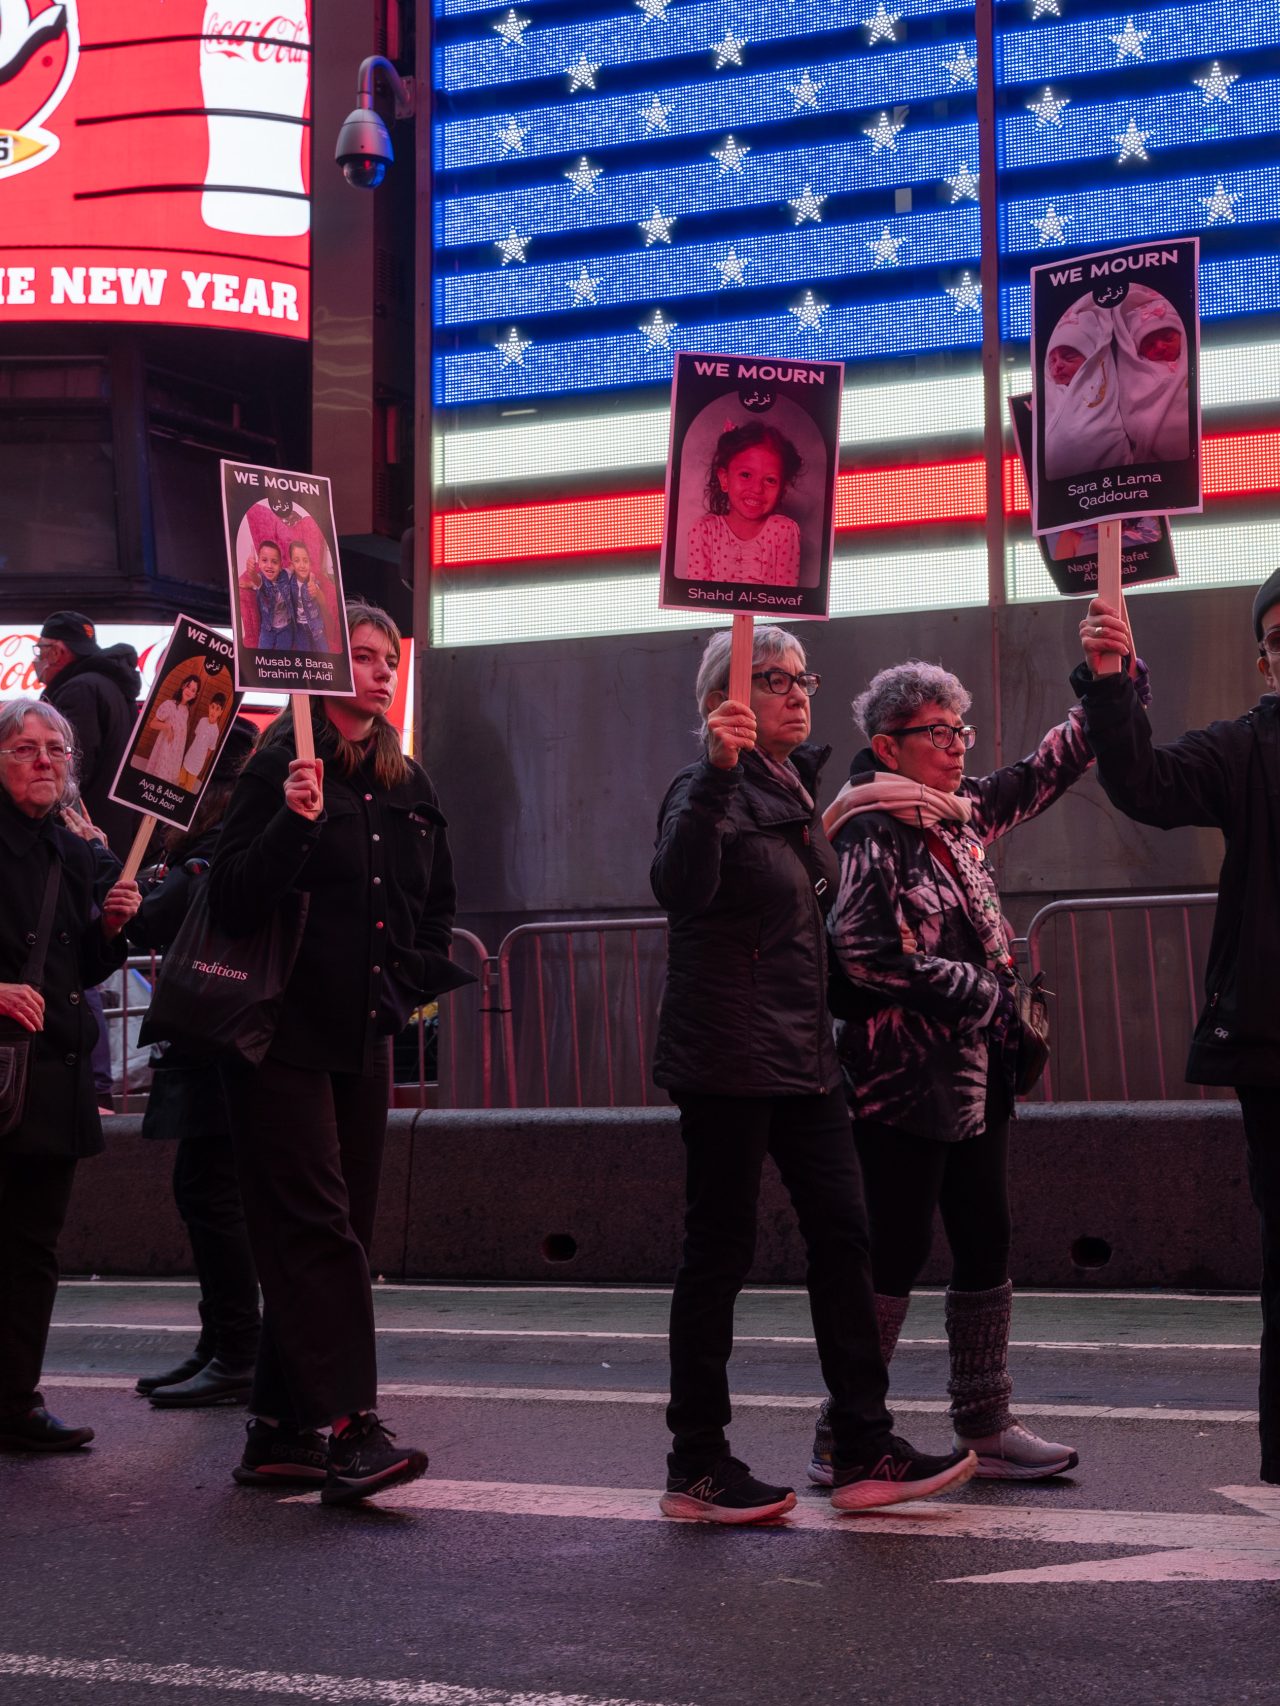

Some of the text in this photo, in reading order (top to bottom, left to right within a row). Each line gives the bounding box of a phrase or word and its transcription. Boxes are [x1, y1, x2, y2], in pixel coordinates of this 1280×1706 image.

[204, 12, 308, 63] Coca-Cola
[1049, 249, 1178, 287] WE MOURN
[0, 267, 299, 321] E NEW YEAR
[1097, 286, 1124, 303] نرثي
[694, 361, 825, 384] WE MOURN
[743, 391, 771, 406] نرثي
[233, 470, 320, 496] WE MOURN
[1067, 473, 1162, 496] Sara & Lama
[1079, 489, 1149, 510] Qaddoura
[1067, 560, 1098, 574] Nagh
[687, 587, 804, 606] Shahd Al-Sawaf
[187, 626, 235, 659] WE MOU
[255, 655, 334, 669] Musab & Baraa
[258, 668, 333, 681] Ibrahim Al-Aidi
[139, 778, 185, 803] Aya & Aboud
[141, 791, 176, 811] Abu Aoun
